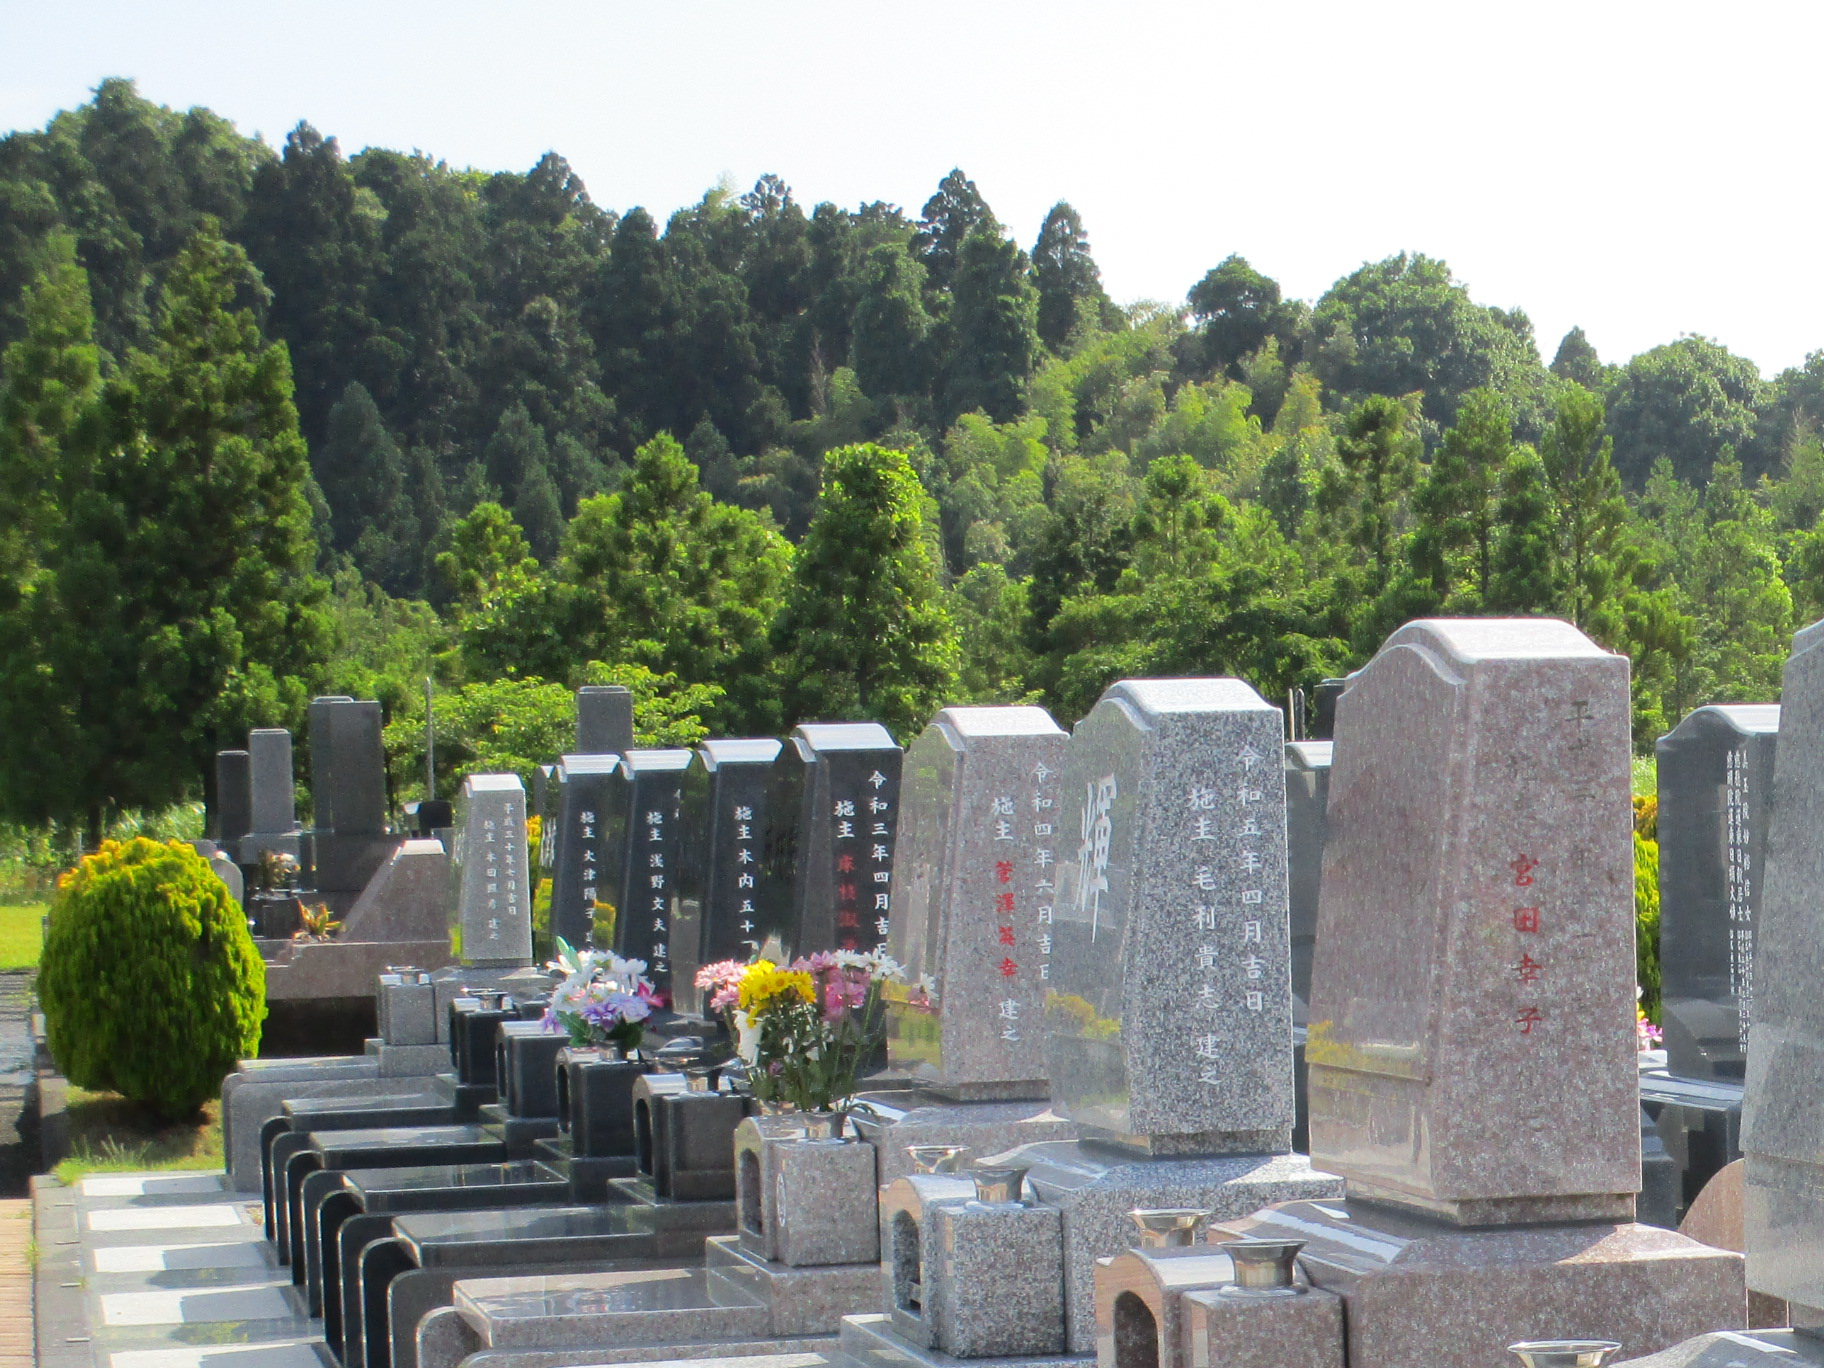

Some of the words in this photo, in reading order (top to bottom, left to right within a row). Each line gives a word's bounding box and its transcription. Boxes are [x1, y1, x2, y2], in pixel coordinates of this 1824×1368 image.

[1237, 744, 1264, 1013] 令和五年四月吉日
